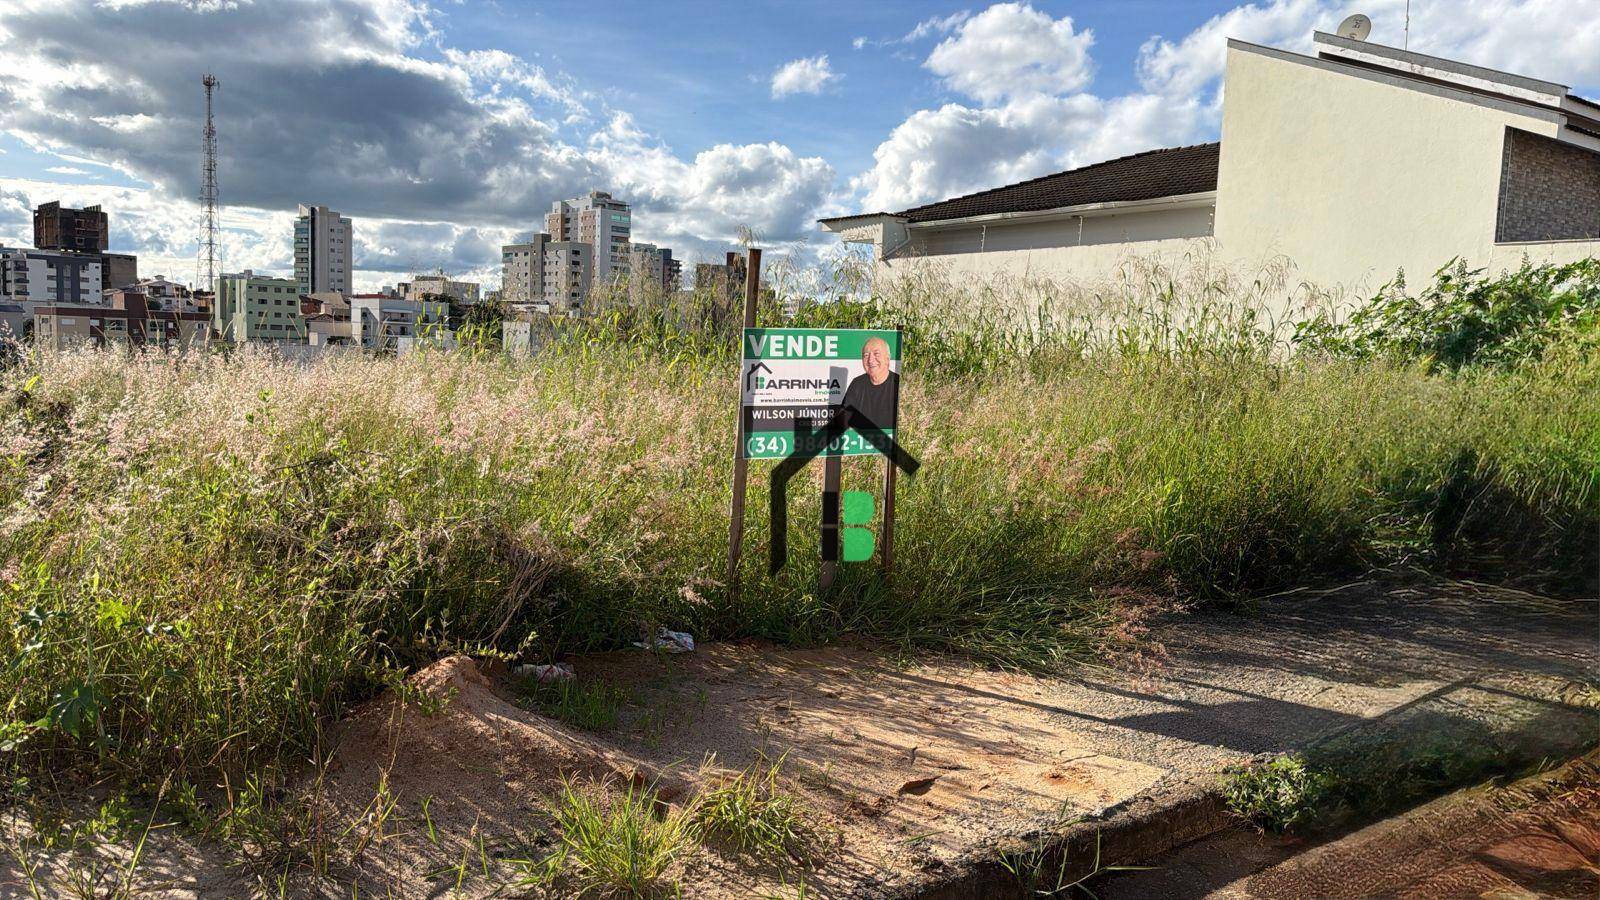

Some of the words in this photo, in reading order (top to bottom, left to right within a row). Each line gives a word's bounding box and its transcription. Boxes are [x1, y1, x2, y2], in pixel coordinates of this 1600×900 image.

[748, 334, 839, 357] VENDE
[755, 376, 841, 389] BARRINHA
[752, 409, 795, 420] WILSON
[796, 407, 835, 419] JÚNIOR
[746, 435, 788, 456] (34)
